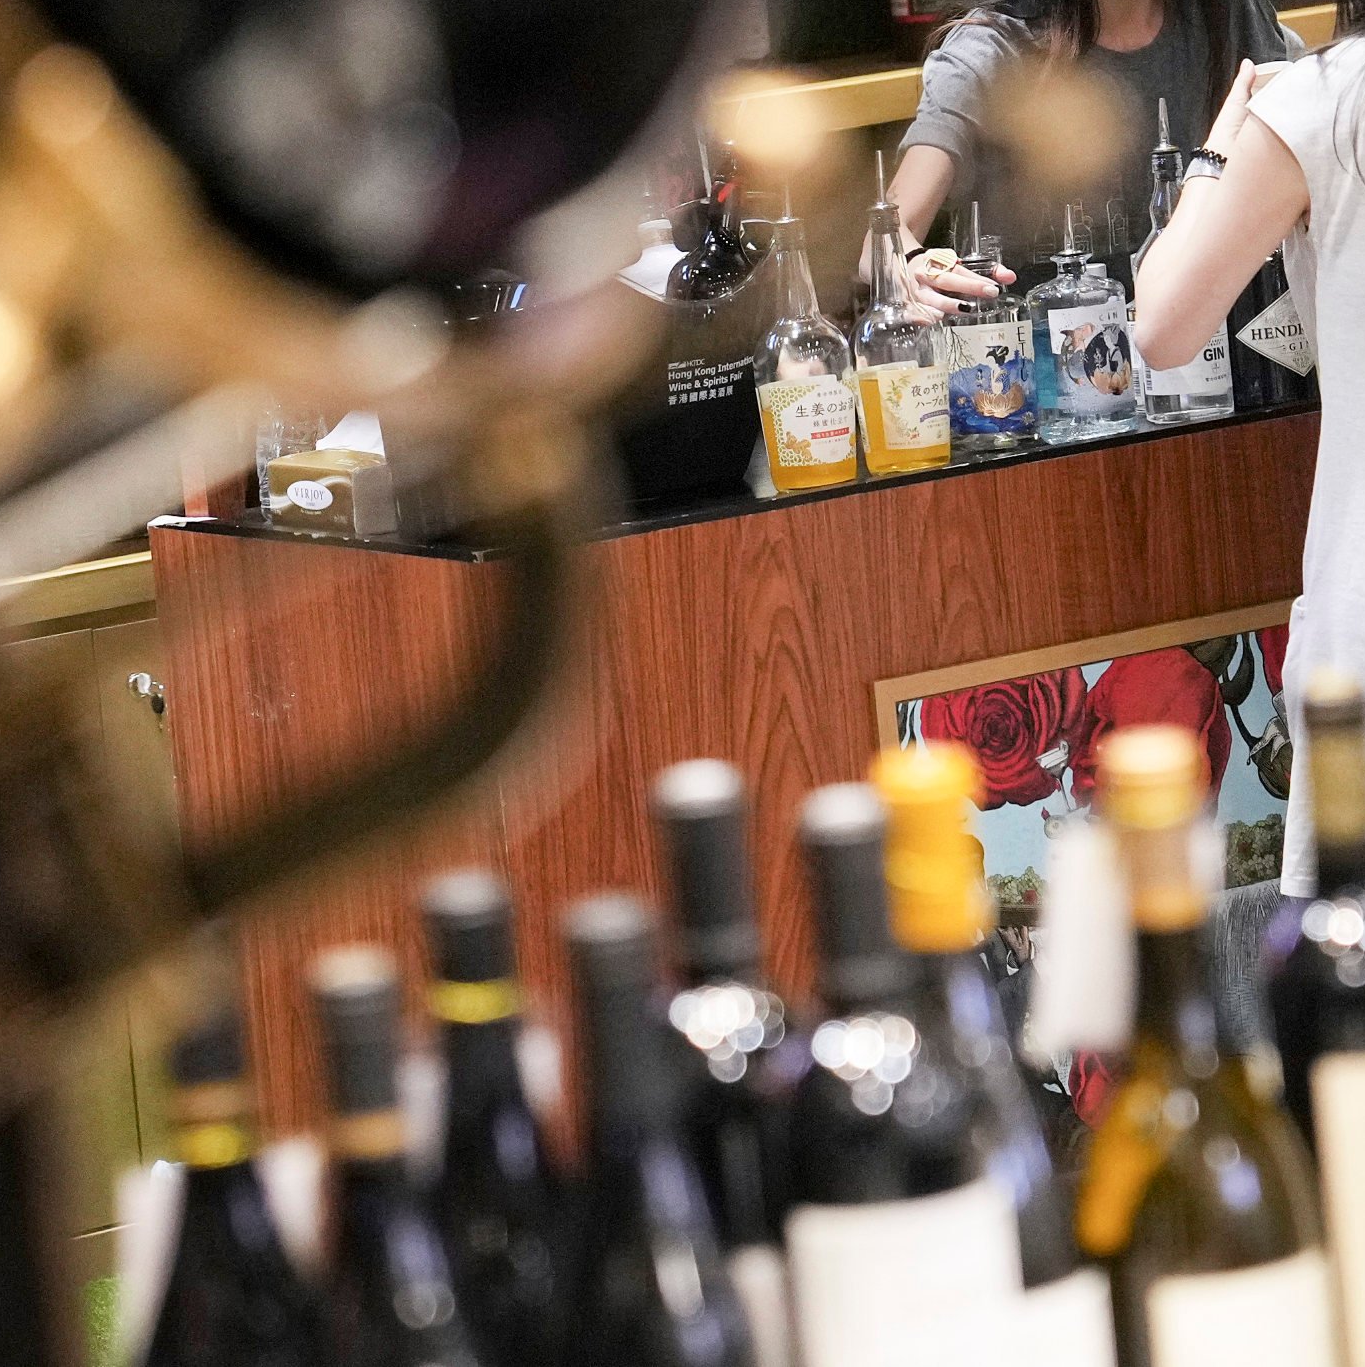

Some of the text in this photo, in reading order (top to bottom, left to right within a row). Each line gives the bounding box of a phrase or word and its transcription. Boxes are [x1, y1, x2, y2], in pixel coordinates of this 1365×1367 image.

[1203, 345, 1225, 362] GIN
[668, 370, 692, 381] Hong
[694, 366, 716, 377] Kong
[668, 371, 744, 392] Wine & Spirits Fair
[668, 385, 734, 406] 香港國際美酒展
[294, 487, 324, 502] VIRJOY
